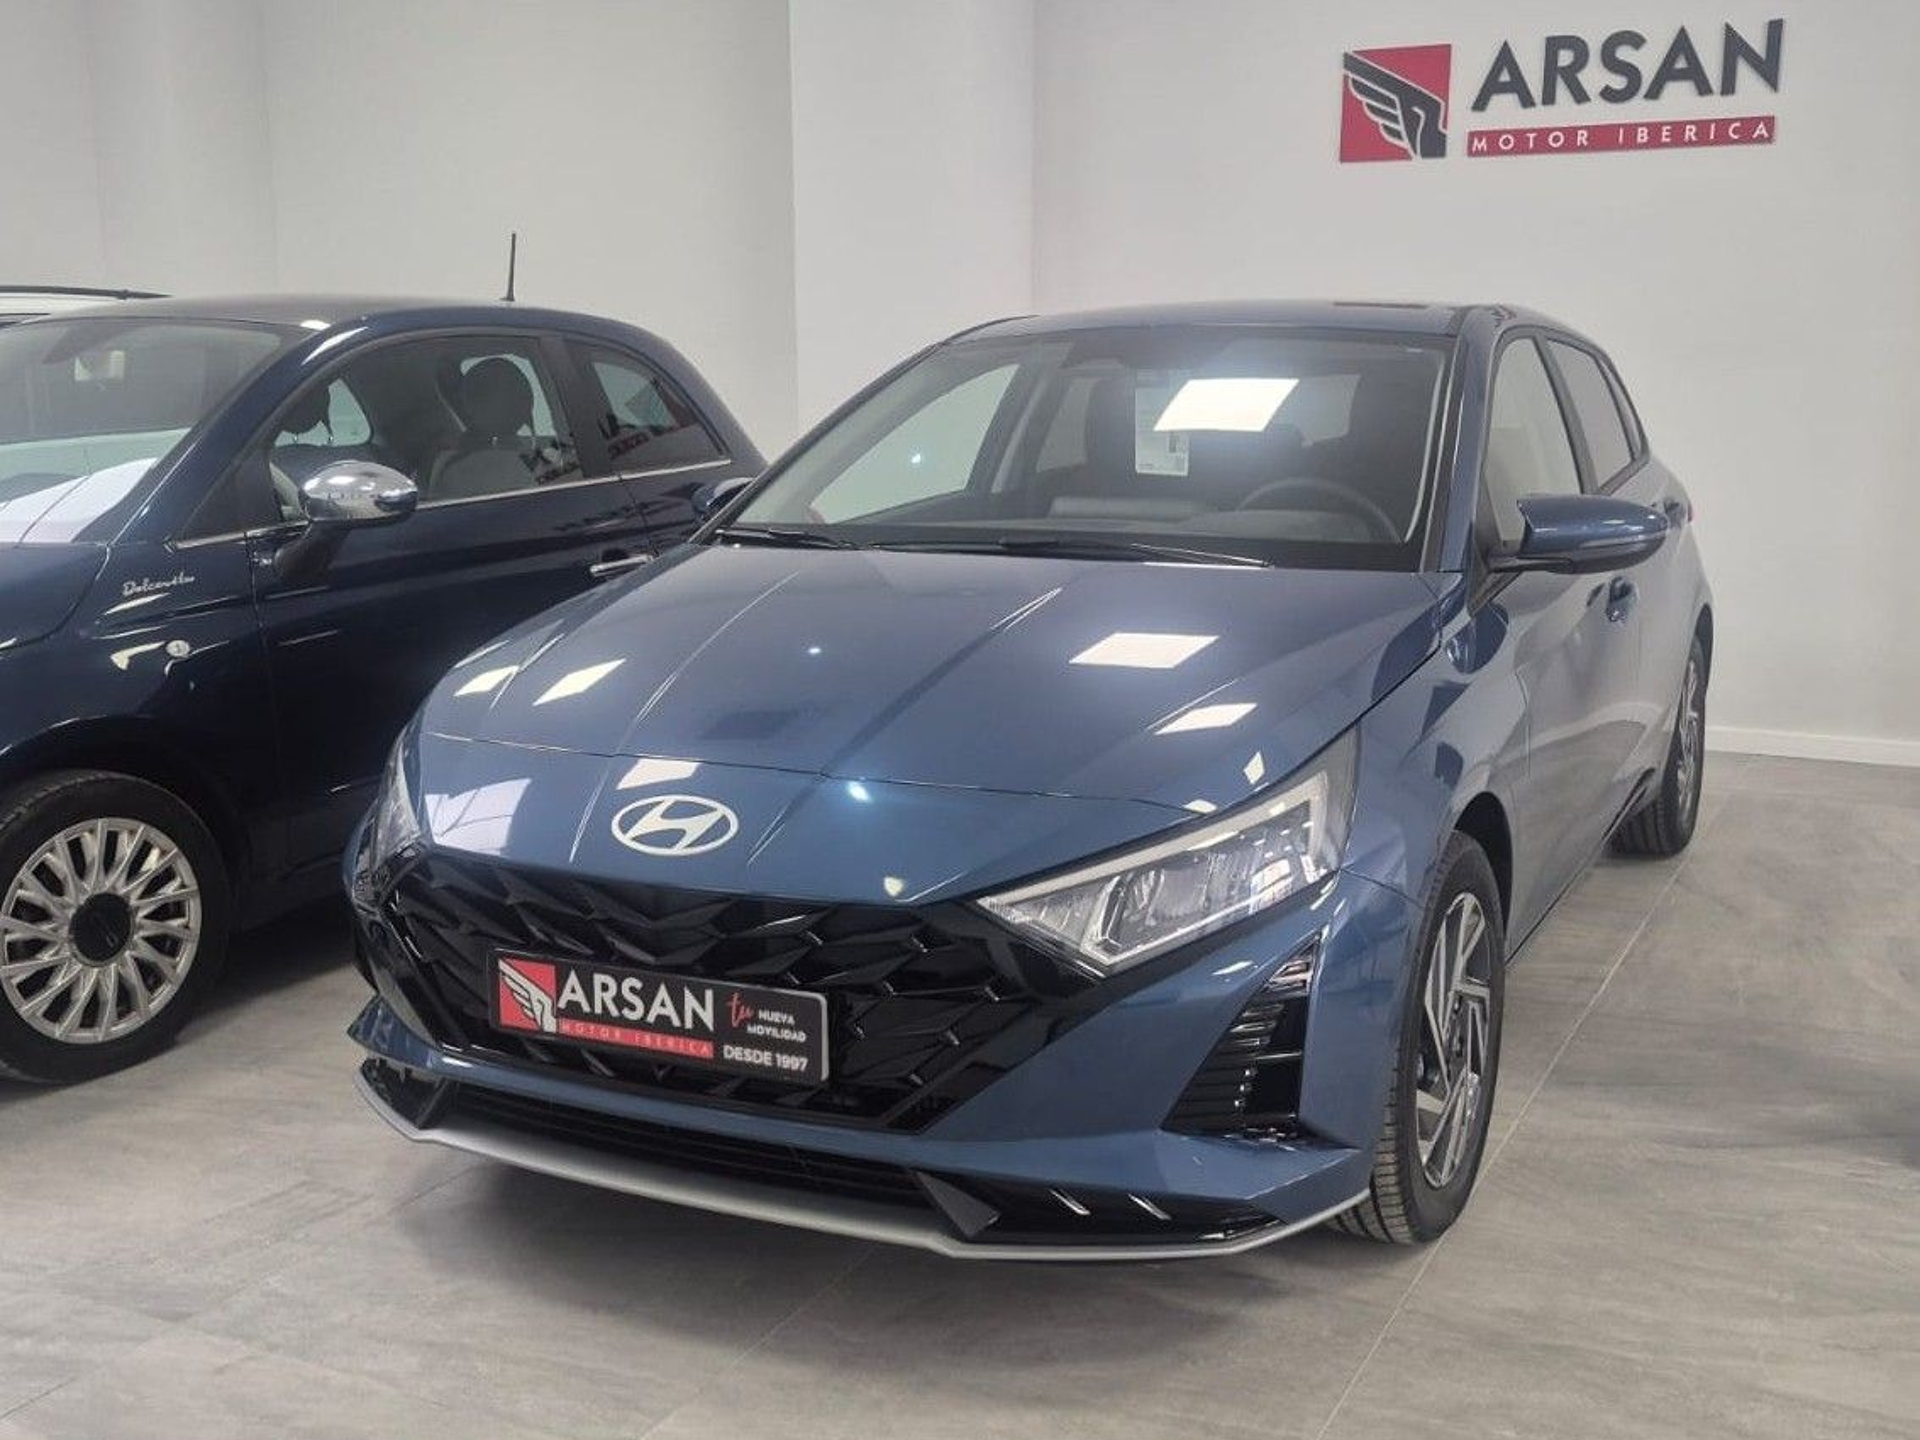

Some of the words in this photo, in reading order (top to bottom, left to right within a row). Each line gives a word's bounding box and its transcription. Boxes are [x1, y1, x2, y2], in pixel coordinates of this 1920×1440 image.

[1471, 18, 1784, 112] ARSAN
[1471, 129, 1589, 152] MOTOR
[1617, 120, 1770, 145] IBERICA
[557, 969, 715, 1032] ARSAN
[723, 1045, 772, 1067] DESDE
